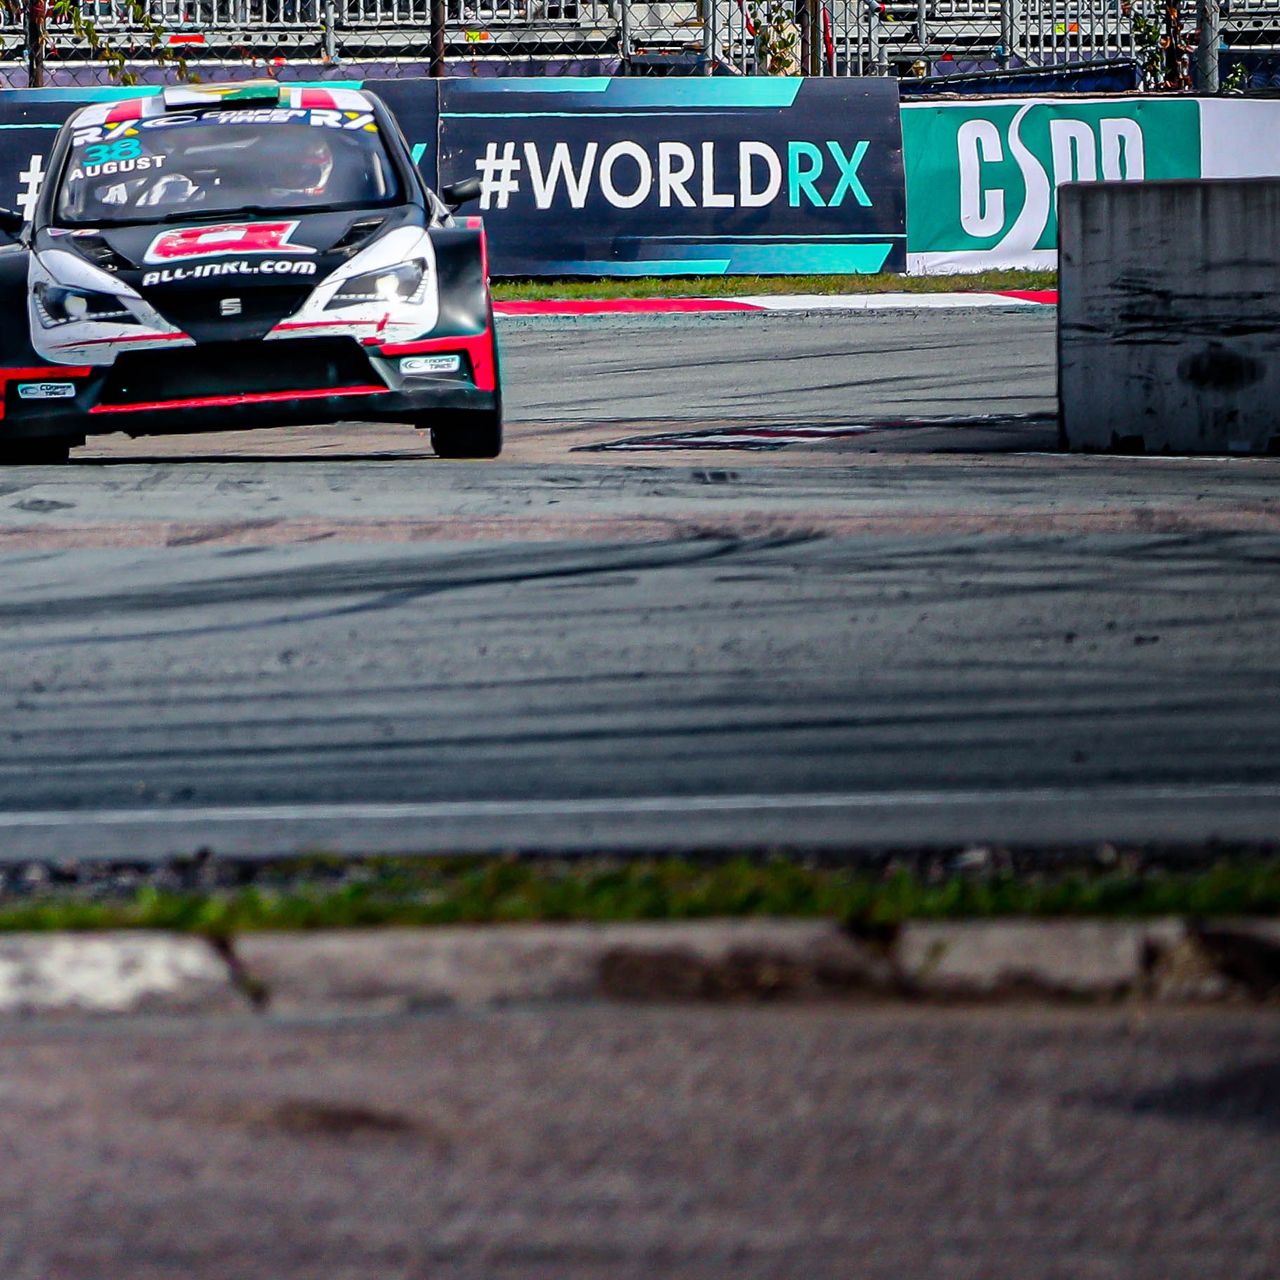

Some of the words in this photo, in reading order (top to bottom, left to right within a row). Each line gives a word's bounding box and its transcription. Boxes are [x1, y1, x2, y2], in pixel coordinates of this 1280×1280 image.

[73, 120, 140, 147] RX
[308, 109, 378, 132] RX
[82, 138, 142, 167] 38
[69, 154, 167, 181] AUGUST
[475, 140, 873, 210] #WORLDRX
